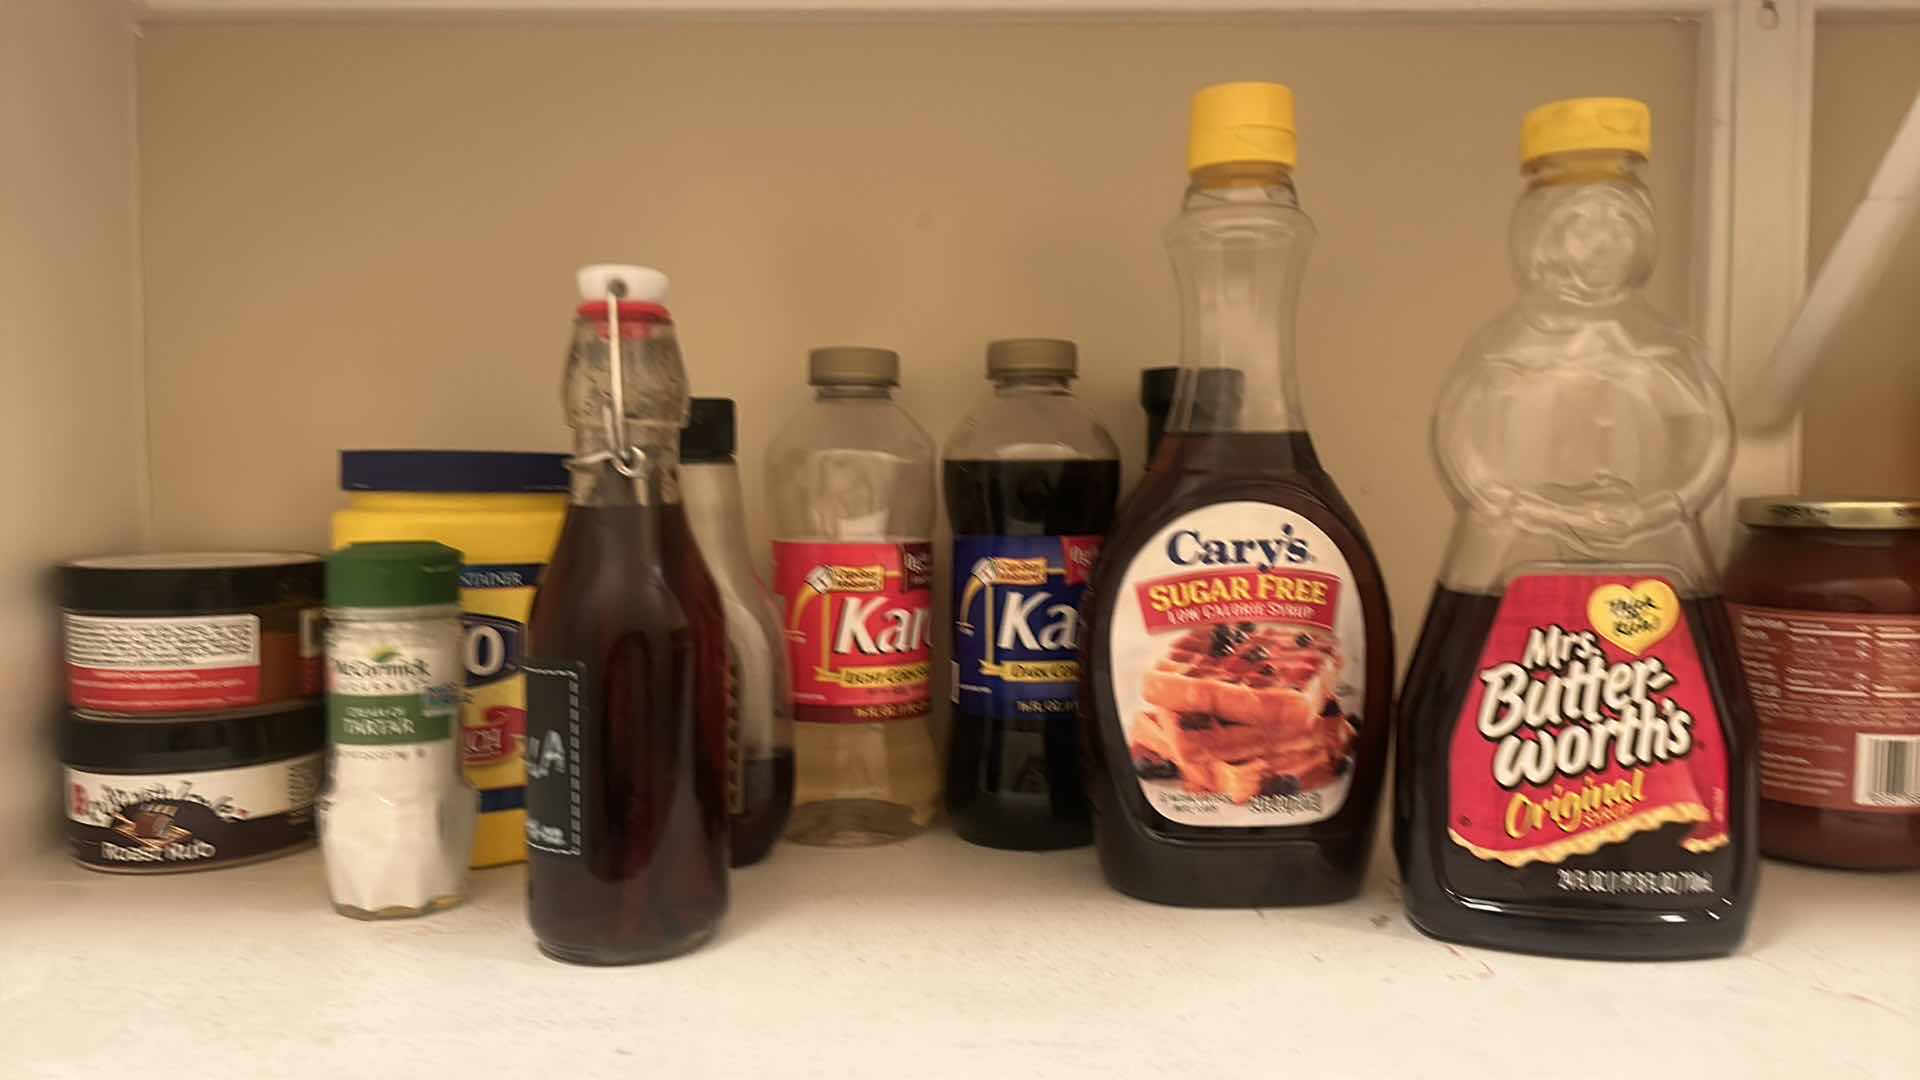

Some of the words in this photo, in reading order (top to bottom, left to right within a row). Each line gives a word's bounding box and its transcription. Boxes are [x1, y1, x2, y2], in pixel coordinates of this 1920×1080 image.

[1167, 523, 1312, 573] Cary's
[1149, 576, 1253, 613] SUGAR
[1257, 573, 1329, 605] FREE
[1493, 697, 1692, 788] worth's
[1505, 769, 1646, 839] Original
